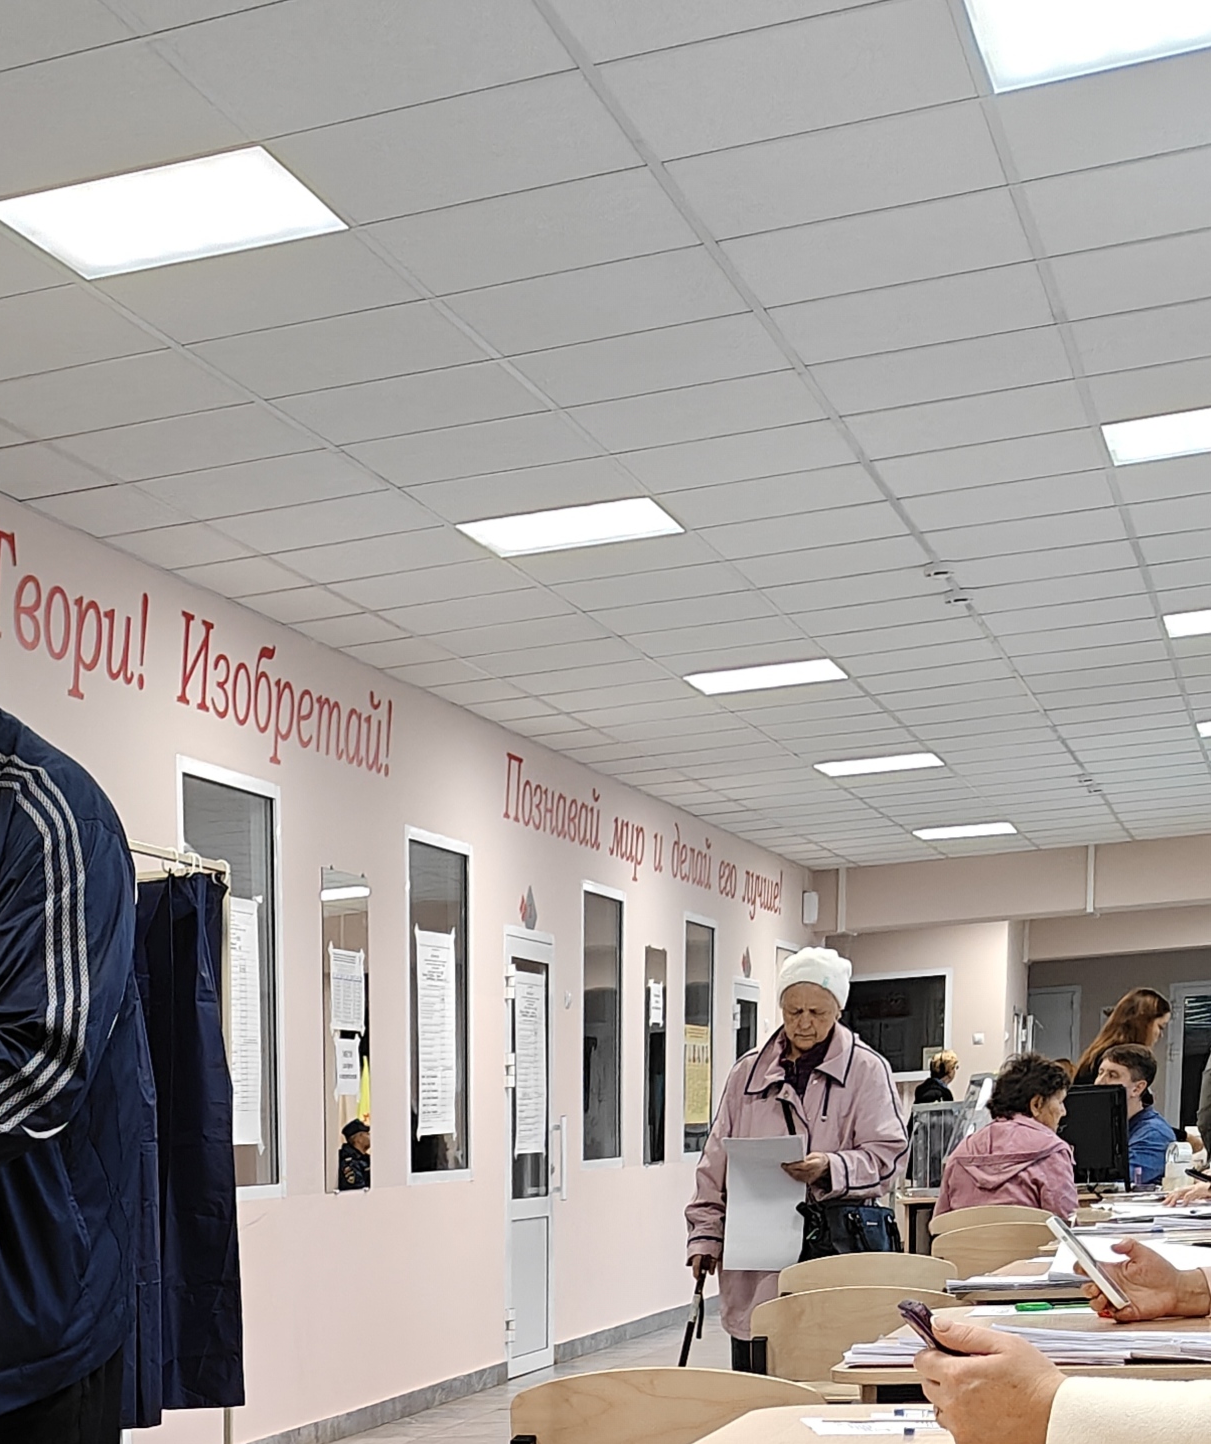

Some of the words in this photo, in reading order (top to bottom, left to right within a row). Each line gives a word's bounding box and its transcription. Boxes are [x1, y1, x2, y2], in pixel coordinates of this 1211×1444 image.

[176, 609, 393, 778] Изобретай!
[503, 752, 601, 851] Познавай
[608, 816, 645, 882] мир
[653, 832, 663, 873] и
[671, 822, 712, 890] делай
[718, 860, 737, 899] его
[741, 869, 783, 921] лучше!
